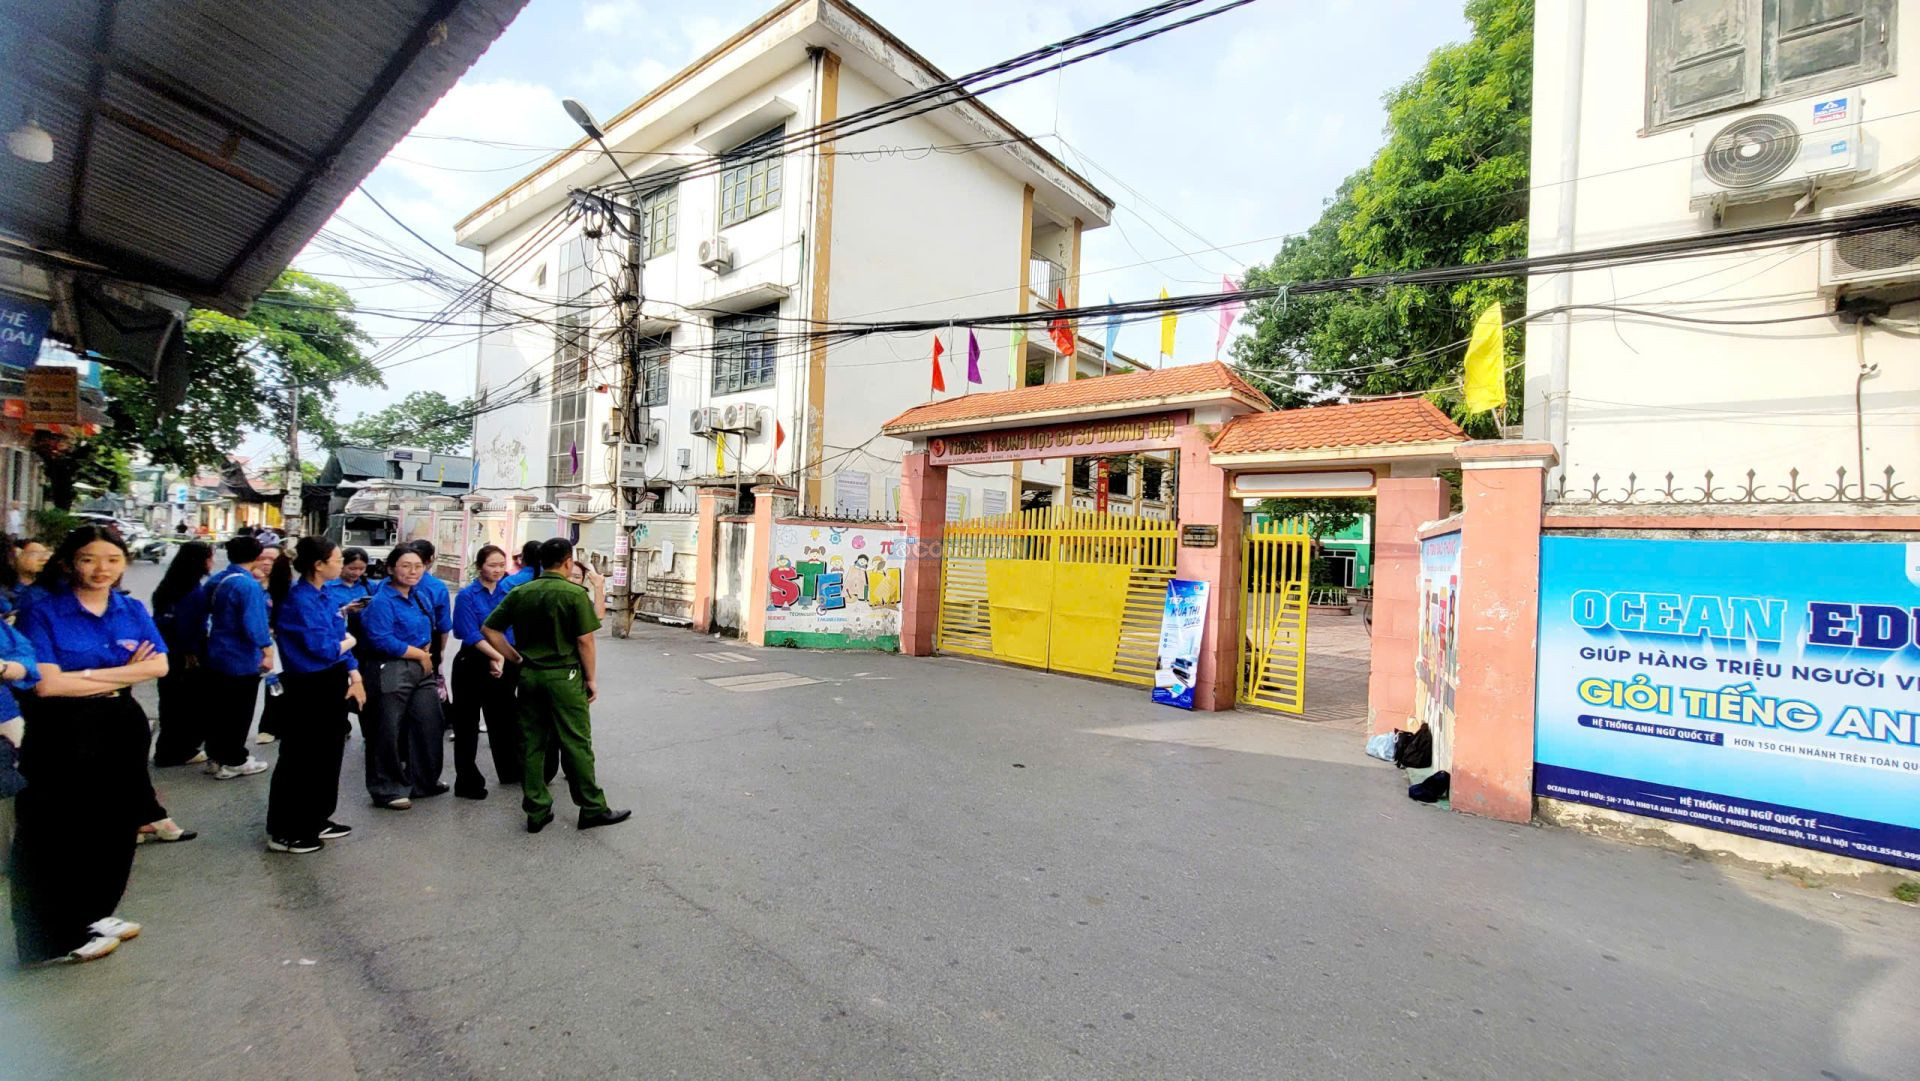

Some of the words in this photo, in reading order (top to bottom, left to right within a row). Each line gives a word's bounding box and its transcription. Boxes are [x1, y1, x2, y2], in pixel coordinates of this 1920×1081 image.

[991, 434, 1026, 452] TRUNG
[1029, 430, 1054, 451] HỌC
[1056, 428, 1073, 446] CƠ
[1075, 424, 1094, 445] SỞ
[1097, 422, 1145, 443] DƯƠNG
[1149, 417, 1175, 441] NỘI
[1571, 589, 1787, 643] OCEAN
[1807, 600, 1920, 651] ED
[1579, 646, 1631, 663] GIÚP
[1638, 650, 1708, 670] HÀNG
[1716, 658, 1782, 680] TRIỆU
[1792, 665, 1884, 688] NGƯỜI
[1579, 674, 1673, 715] GIỎI
[1680, 681, 1821, 732] TIẾNG
[1827, 706, 1920, 746] AN
[1592, 718, 1604, 729] HỆ
[1605, 719, 1634, 731] THỐNG
[1635, 723, 1655, 734] ANH
[1656, 726, 1677, 737] NGỮ
[1678, 728, 1703, 741] QUỐC
[1704, 731, 1716, 743] TẾ
[1734, 738, 1755, 748] HƠN
[1758, 741, 1776, 751] 150
[1779, 744, 1796, 753] CHI
[1799, 746, 1836, 759] NHÁNH
[1840, 751, 1867, 764] TRÊN
[1870, 756, 1900, 768] TOÀN
[1546, 784, 1567, 794] OCEAN
[1567, 787, 1580, 796] EDU
[1659, 805, 1689, 817] ANLAND
[1759, 823, 1788, 835] DƯƠNG
[1819, 834, 1832, 844] HÀ
[1833, 838, 1849, 848] NỘI
[1679, 795, 1693, 808] HỆ
[1694, 797, 1726, 812] THỐNG
[1727, 804, 1749, 817] ANH
[1751, 806, 1774, 820] NGỮ
[1774, 812, 1802, 827] QUỐC
[1803, 817, 1818, 829] TẾ
